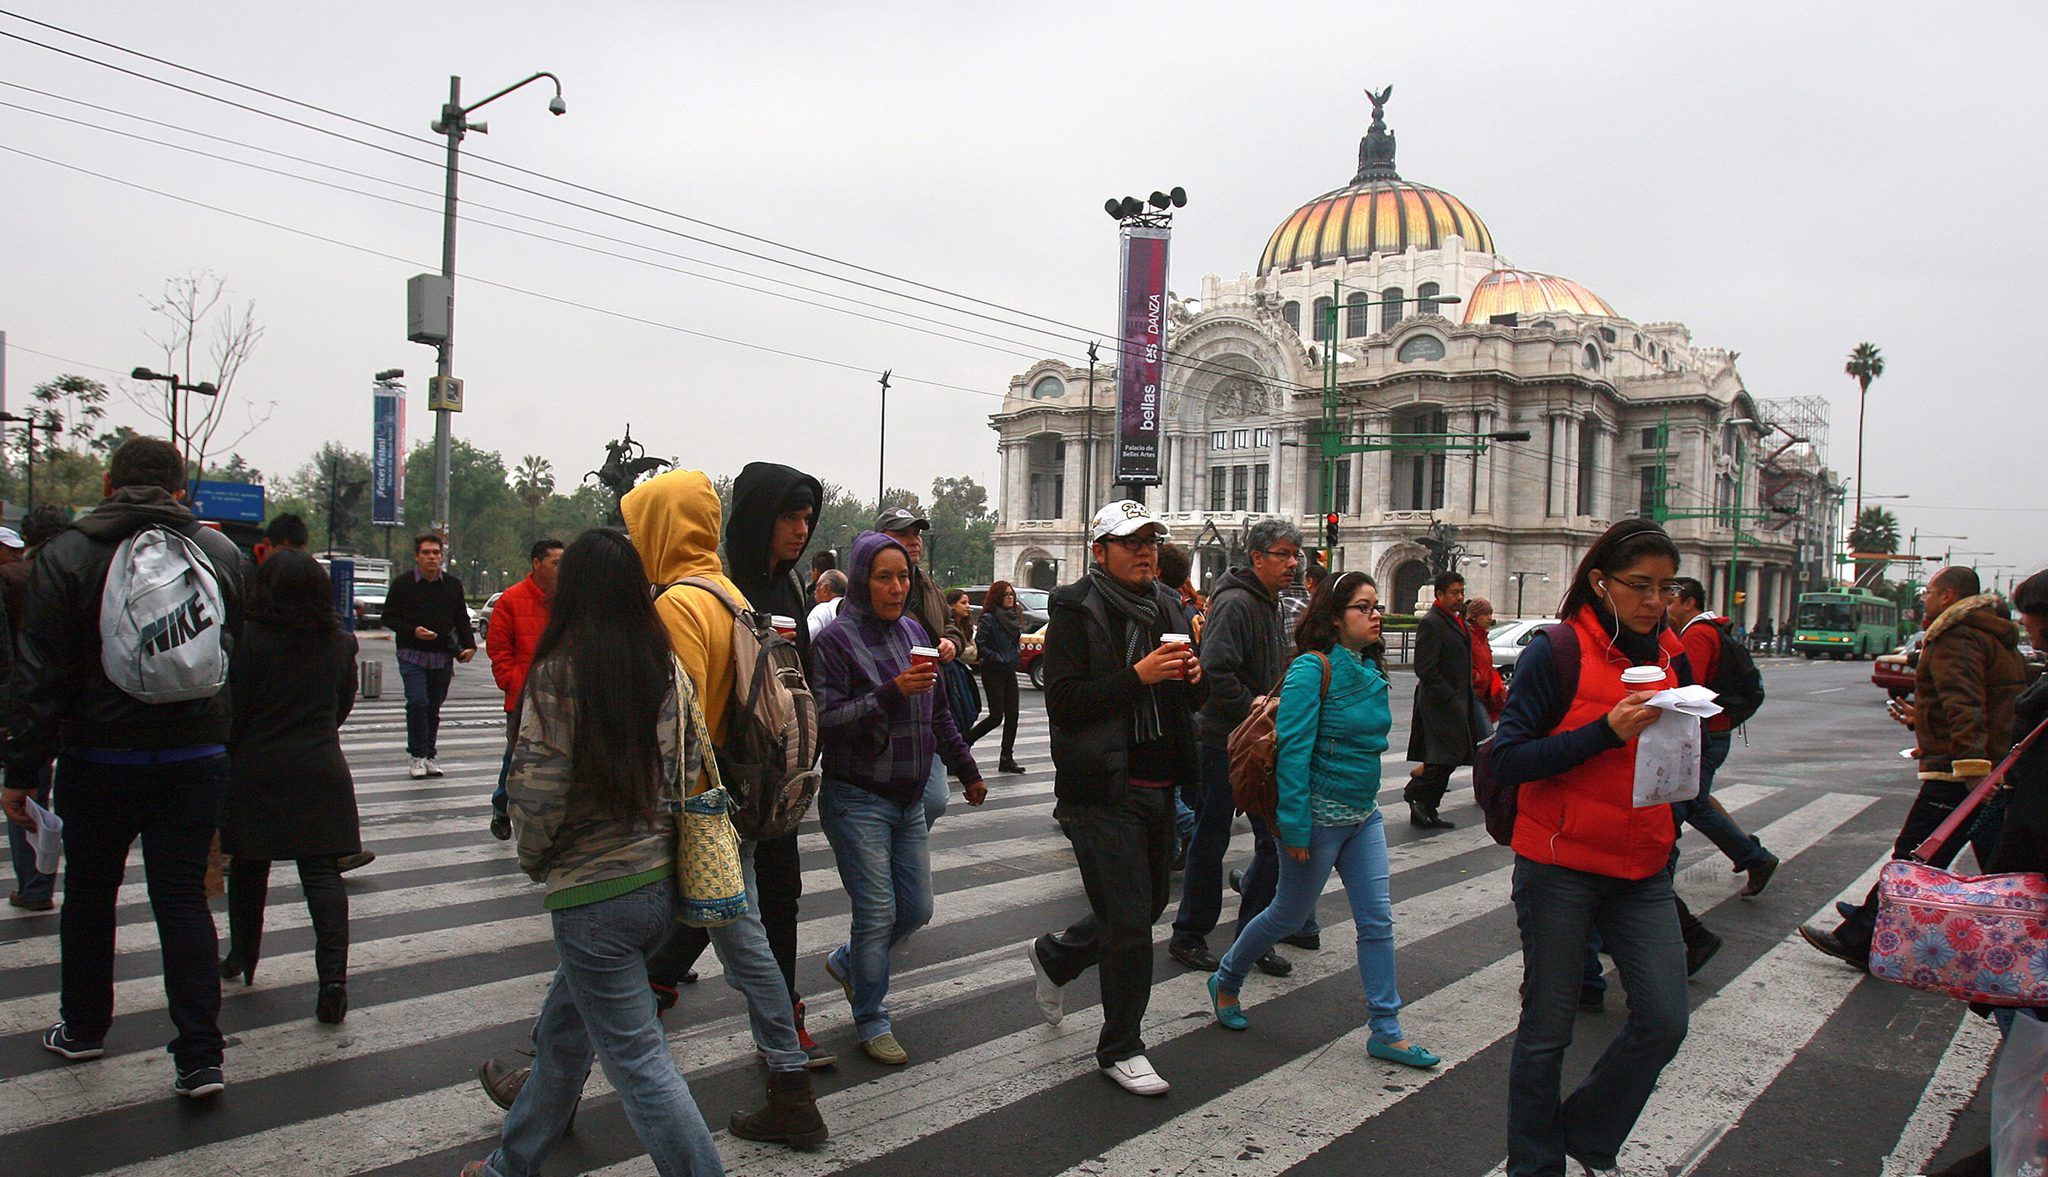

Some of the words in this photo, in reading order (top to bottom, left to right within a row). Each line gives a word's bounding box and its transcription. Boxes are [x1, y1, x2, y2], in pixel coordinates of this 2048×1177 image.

[1140, 384, 1156, 431] bellas
[1148, 294, 1160, 334] DANZA
[141, 590, 214, 656] NIKE
